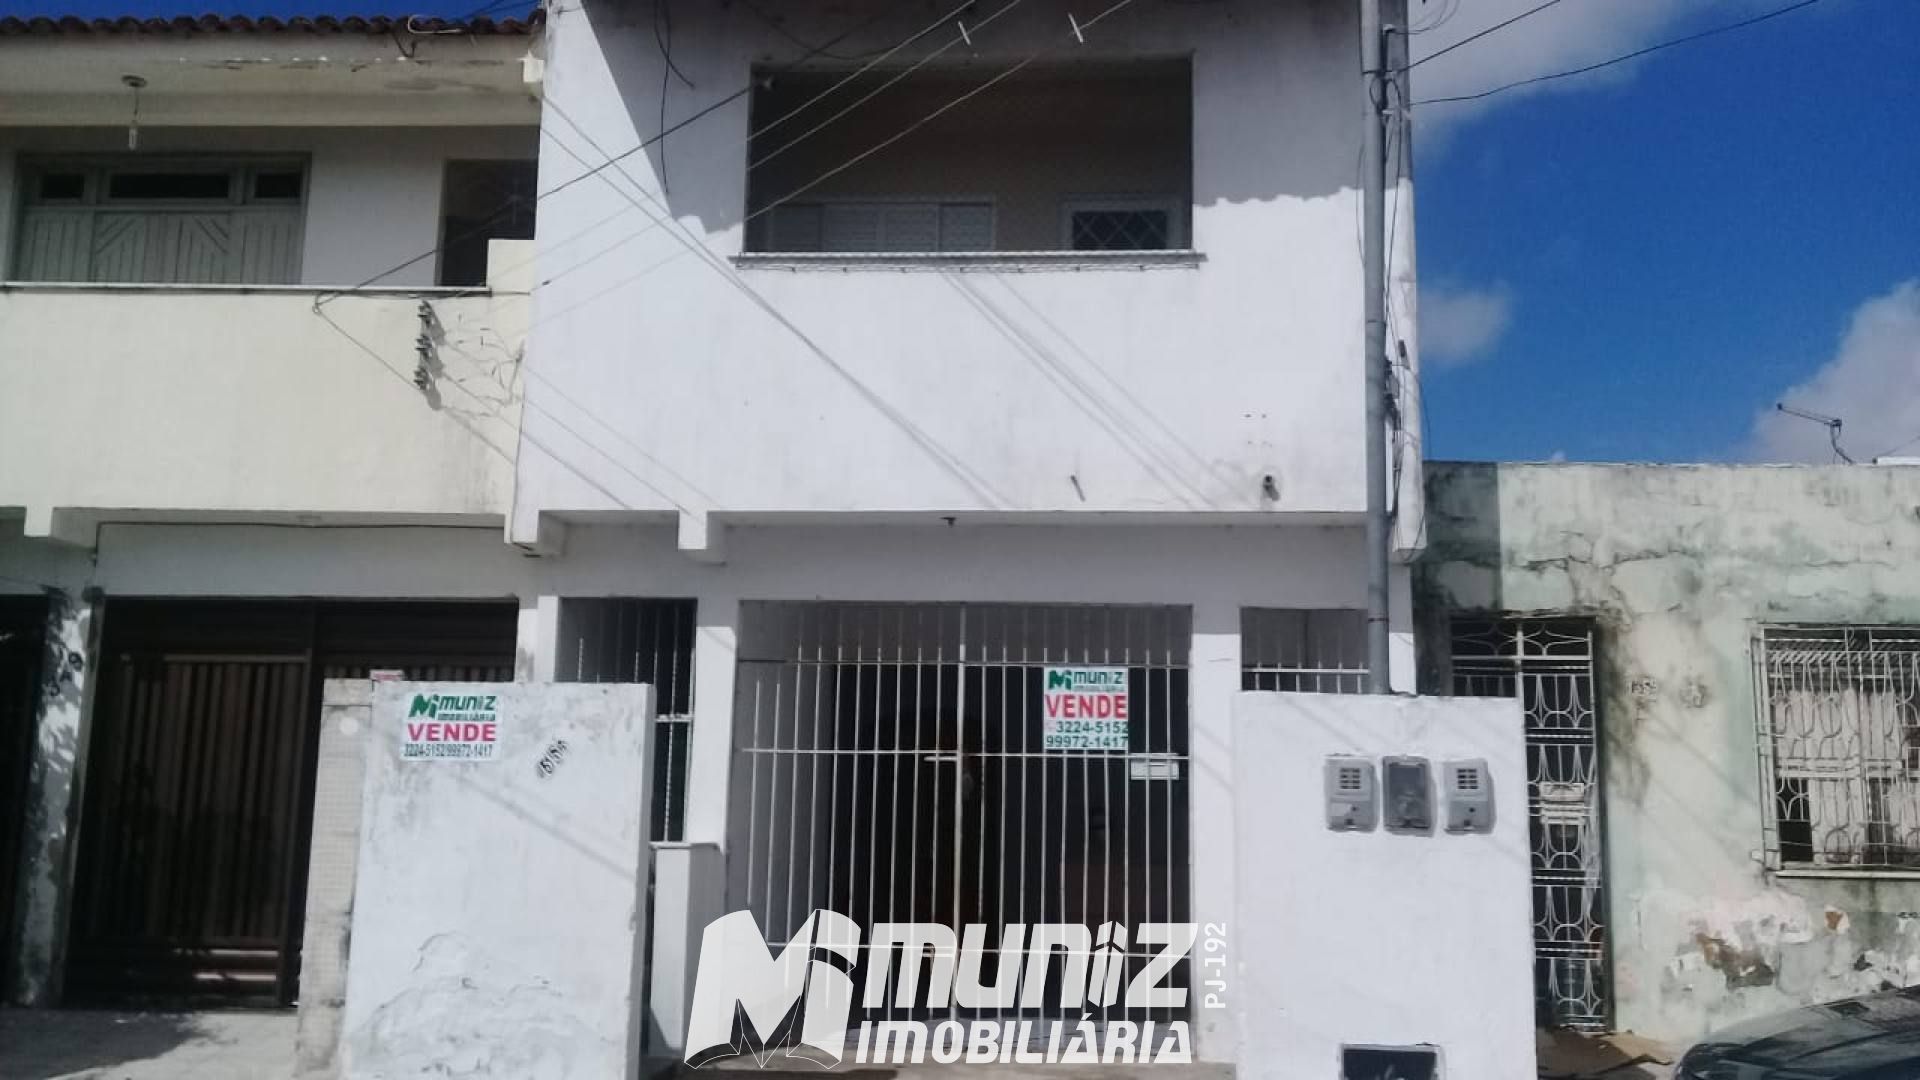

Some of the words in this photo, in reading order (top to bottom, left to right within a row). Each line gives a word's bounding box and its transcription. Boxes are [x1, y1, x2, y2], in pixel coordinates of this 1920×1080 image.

[1045, 694, 1128, 718] VENDE
[408, 723, 497, 741] VENDE
[1056, 721, 1128, 733] 3224-5152
[1046, 735, 1128, 747] 99972-1417
